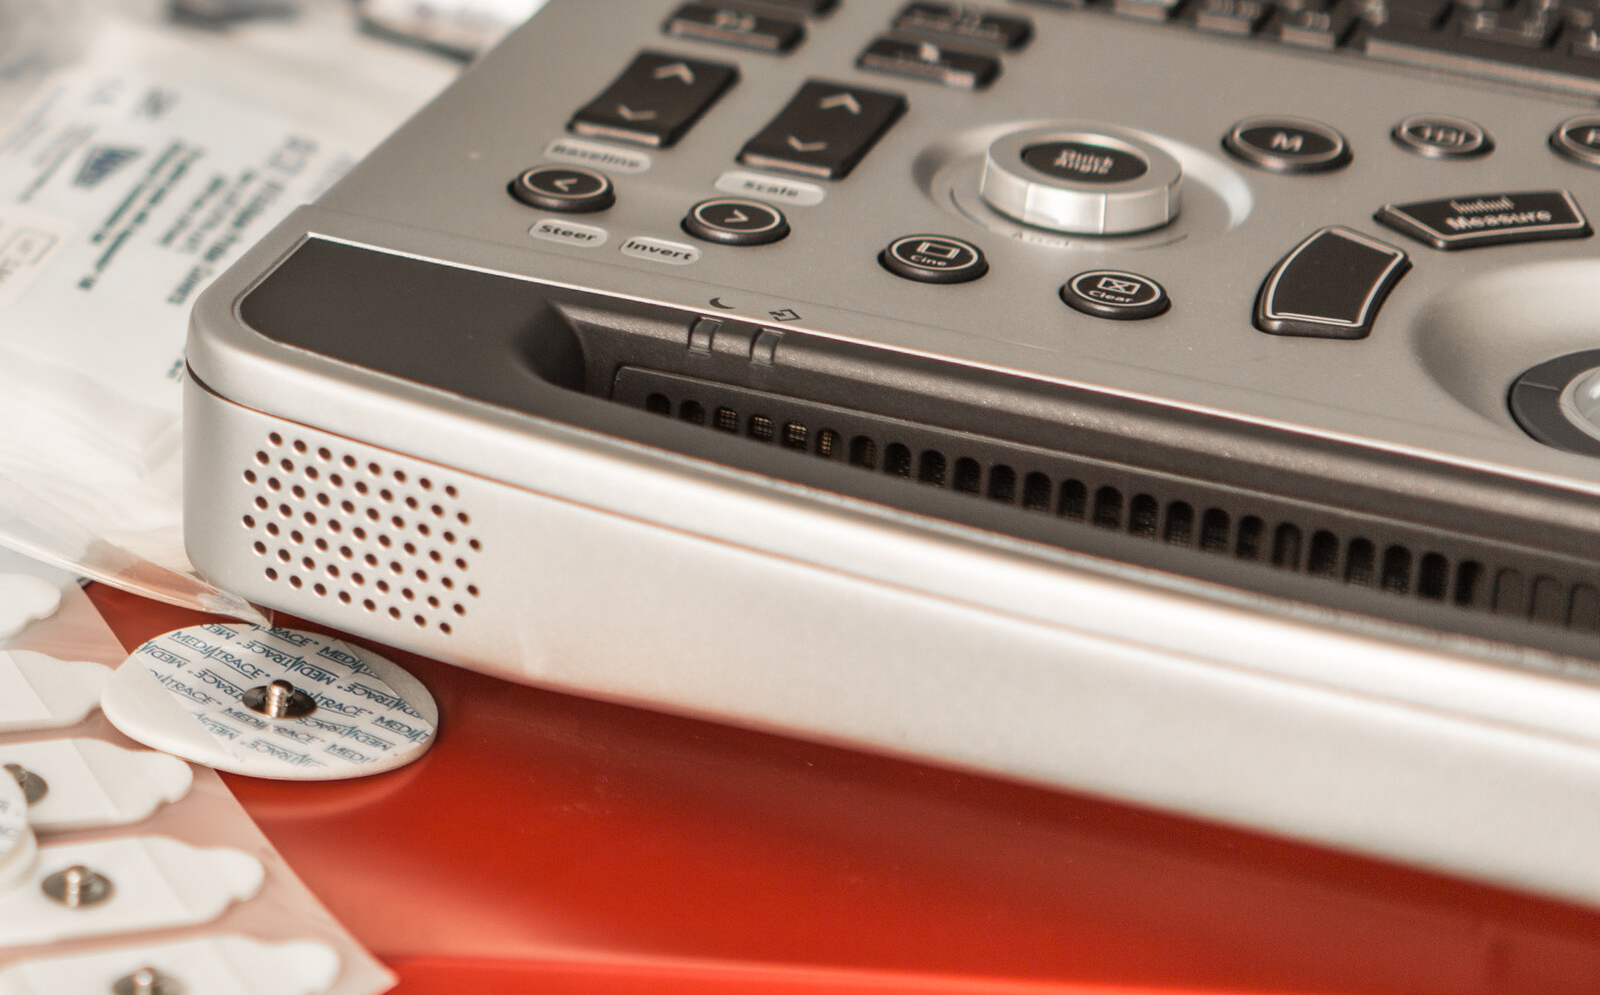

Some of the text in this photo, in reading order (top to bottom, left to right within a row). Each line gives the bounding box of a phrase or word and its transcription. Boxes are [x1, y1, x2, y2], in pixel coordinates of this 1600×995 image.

[1270, 132, 1303, 152] M
[741, 179, 799, 198] Scale
[1445, 209, 1552, 231] Measure
[538, 223, 597, 241] Steer
[625, 240, 693, 261] Invert
[910, 254, 948, 268] Cine
[1088, 289, 1134, 304] Clear
